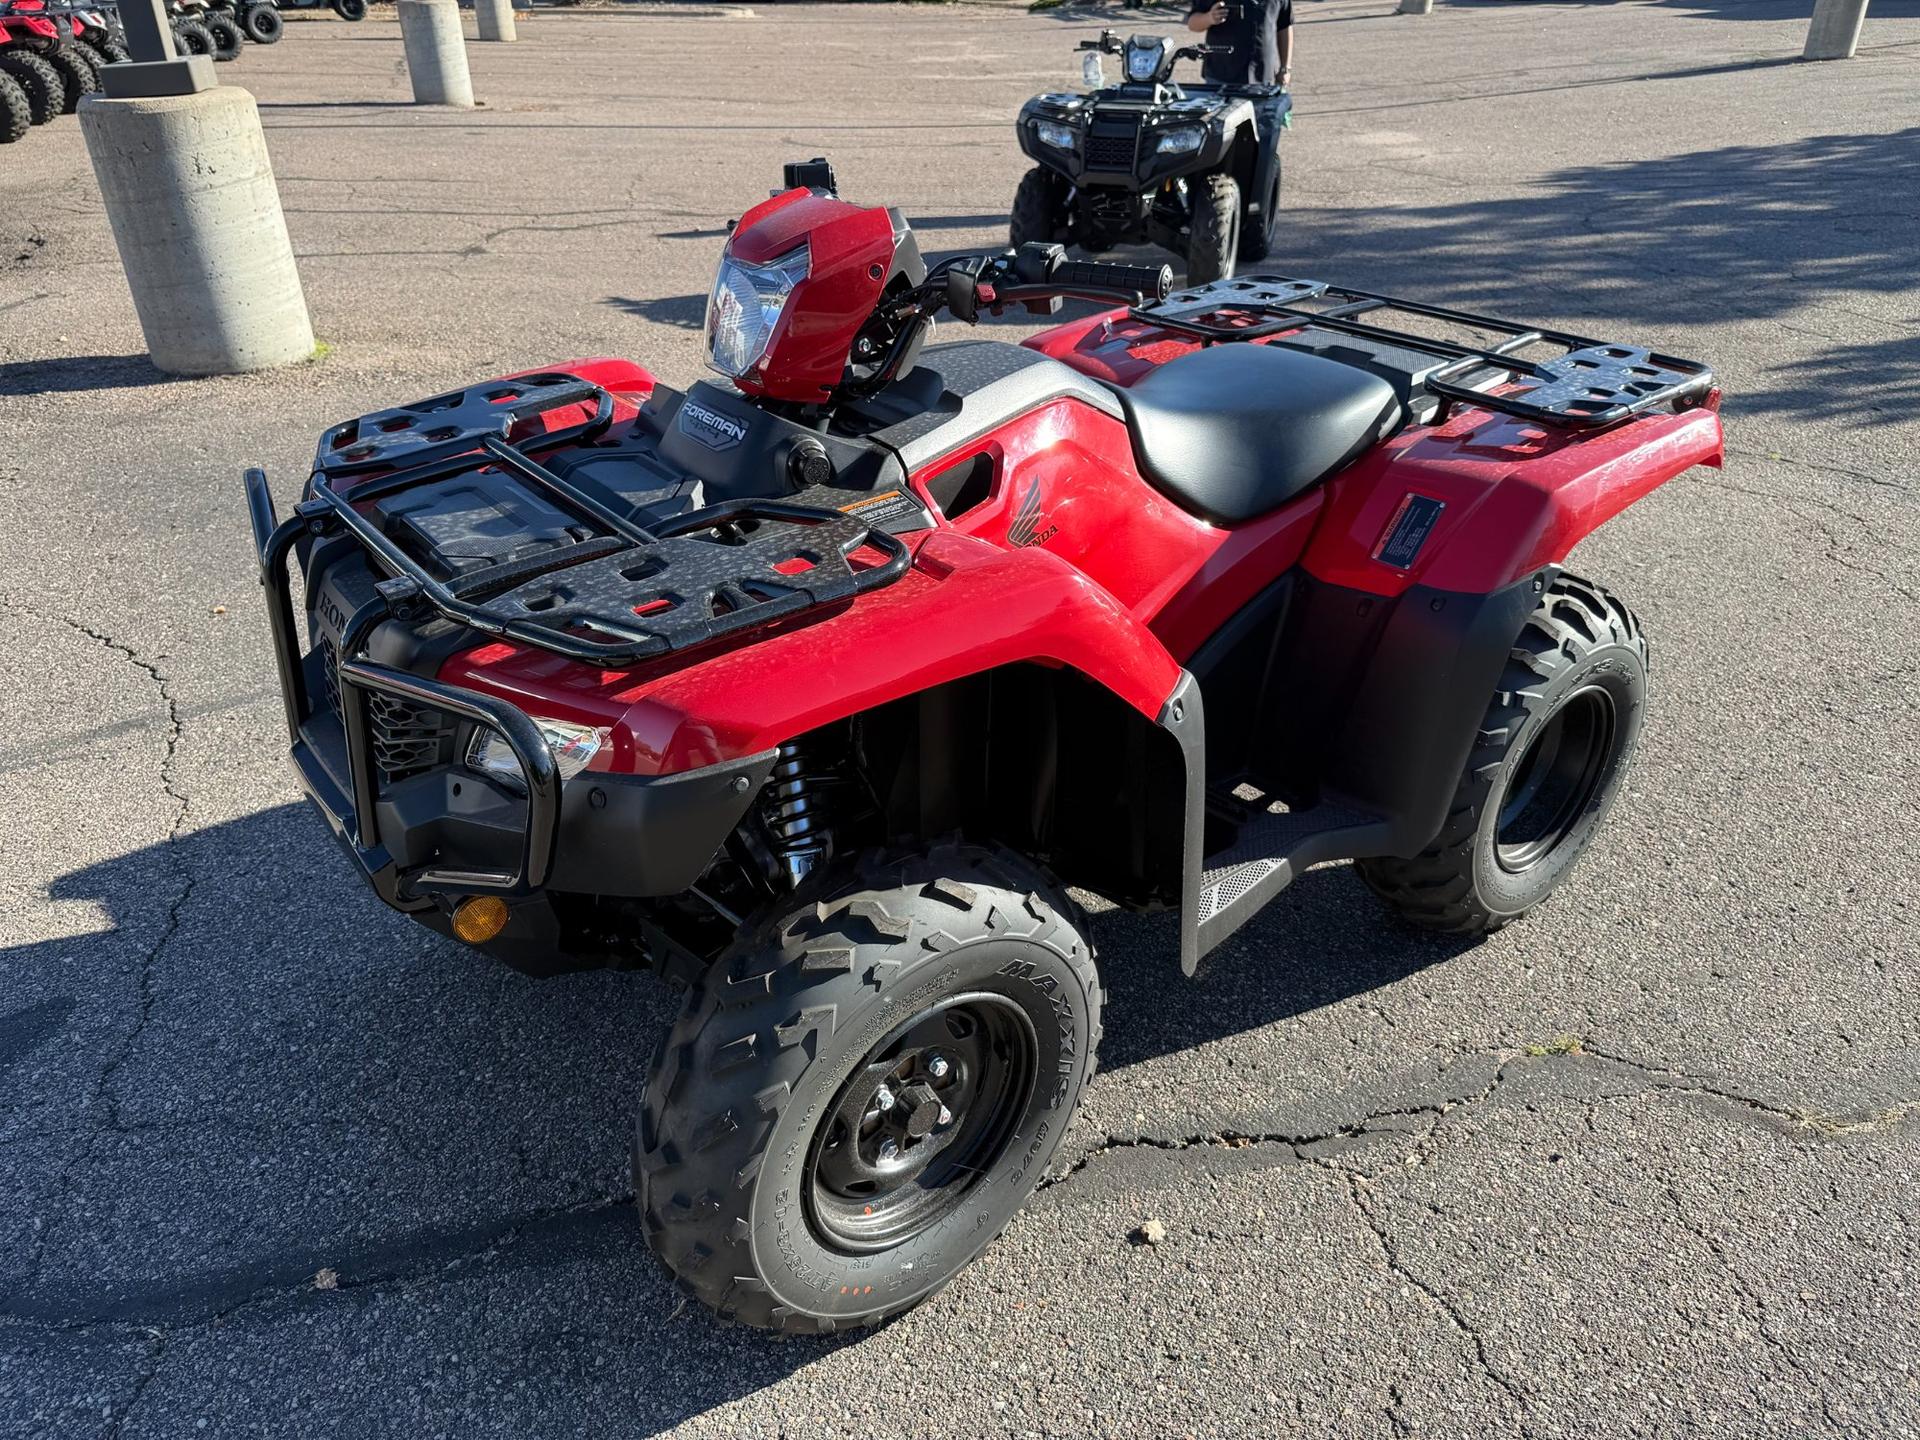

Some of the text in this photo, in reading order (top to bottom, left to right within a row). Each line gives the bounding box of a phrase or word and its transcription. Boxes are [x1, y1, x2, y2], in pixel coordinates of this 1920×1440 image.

[681, 402, 746, 441] FOREMAN
[1025, 524, 1060, 548] NDA
[320, 591, 349, 634] HON
[996, 957, 1076, 1111] MAXXIS
